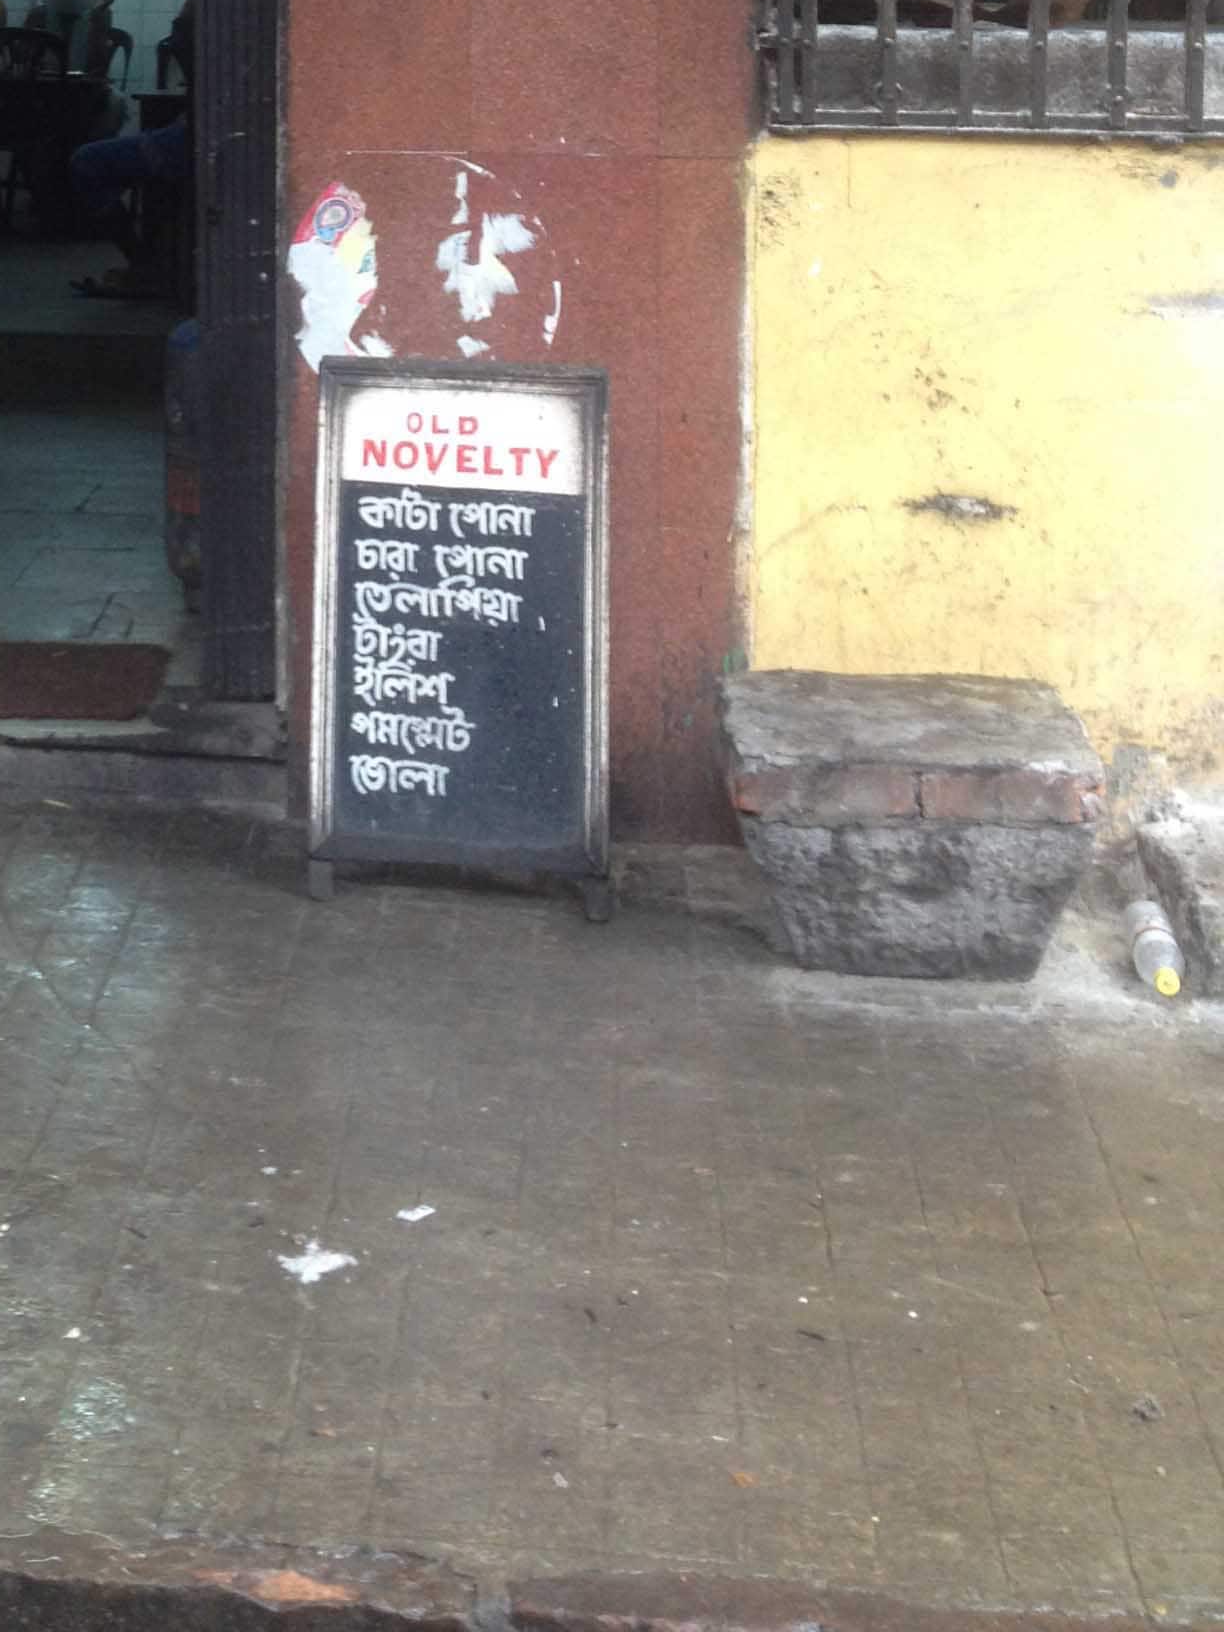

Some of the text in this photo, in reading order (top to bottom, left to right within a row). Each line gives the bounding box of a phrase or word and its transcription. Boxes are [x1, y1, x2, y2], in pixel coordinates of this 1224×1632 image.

[407, 412, 479, 436] OLD
[362, 439, 560, 479] NOVELTY
[358, 487, 536, 538] কাটা পোনা
[354, 538, 529, 581] চারা পোনা
[353, 574, 524, 628] তেলাপিয়া
[353, 654, 456, 706] ইলিশ
[348, 754, 451, 797] ভোলা
